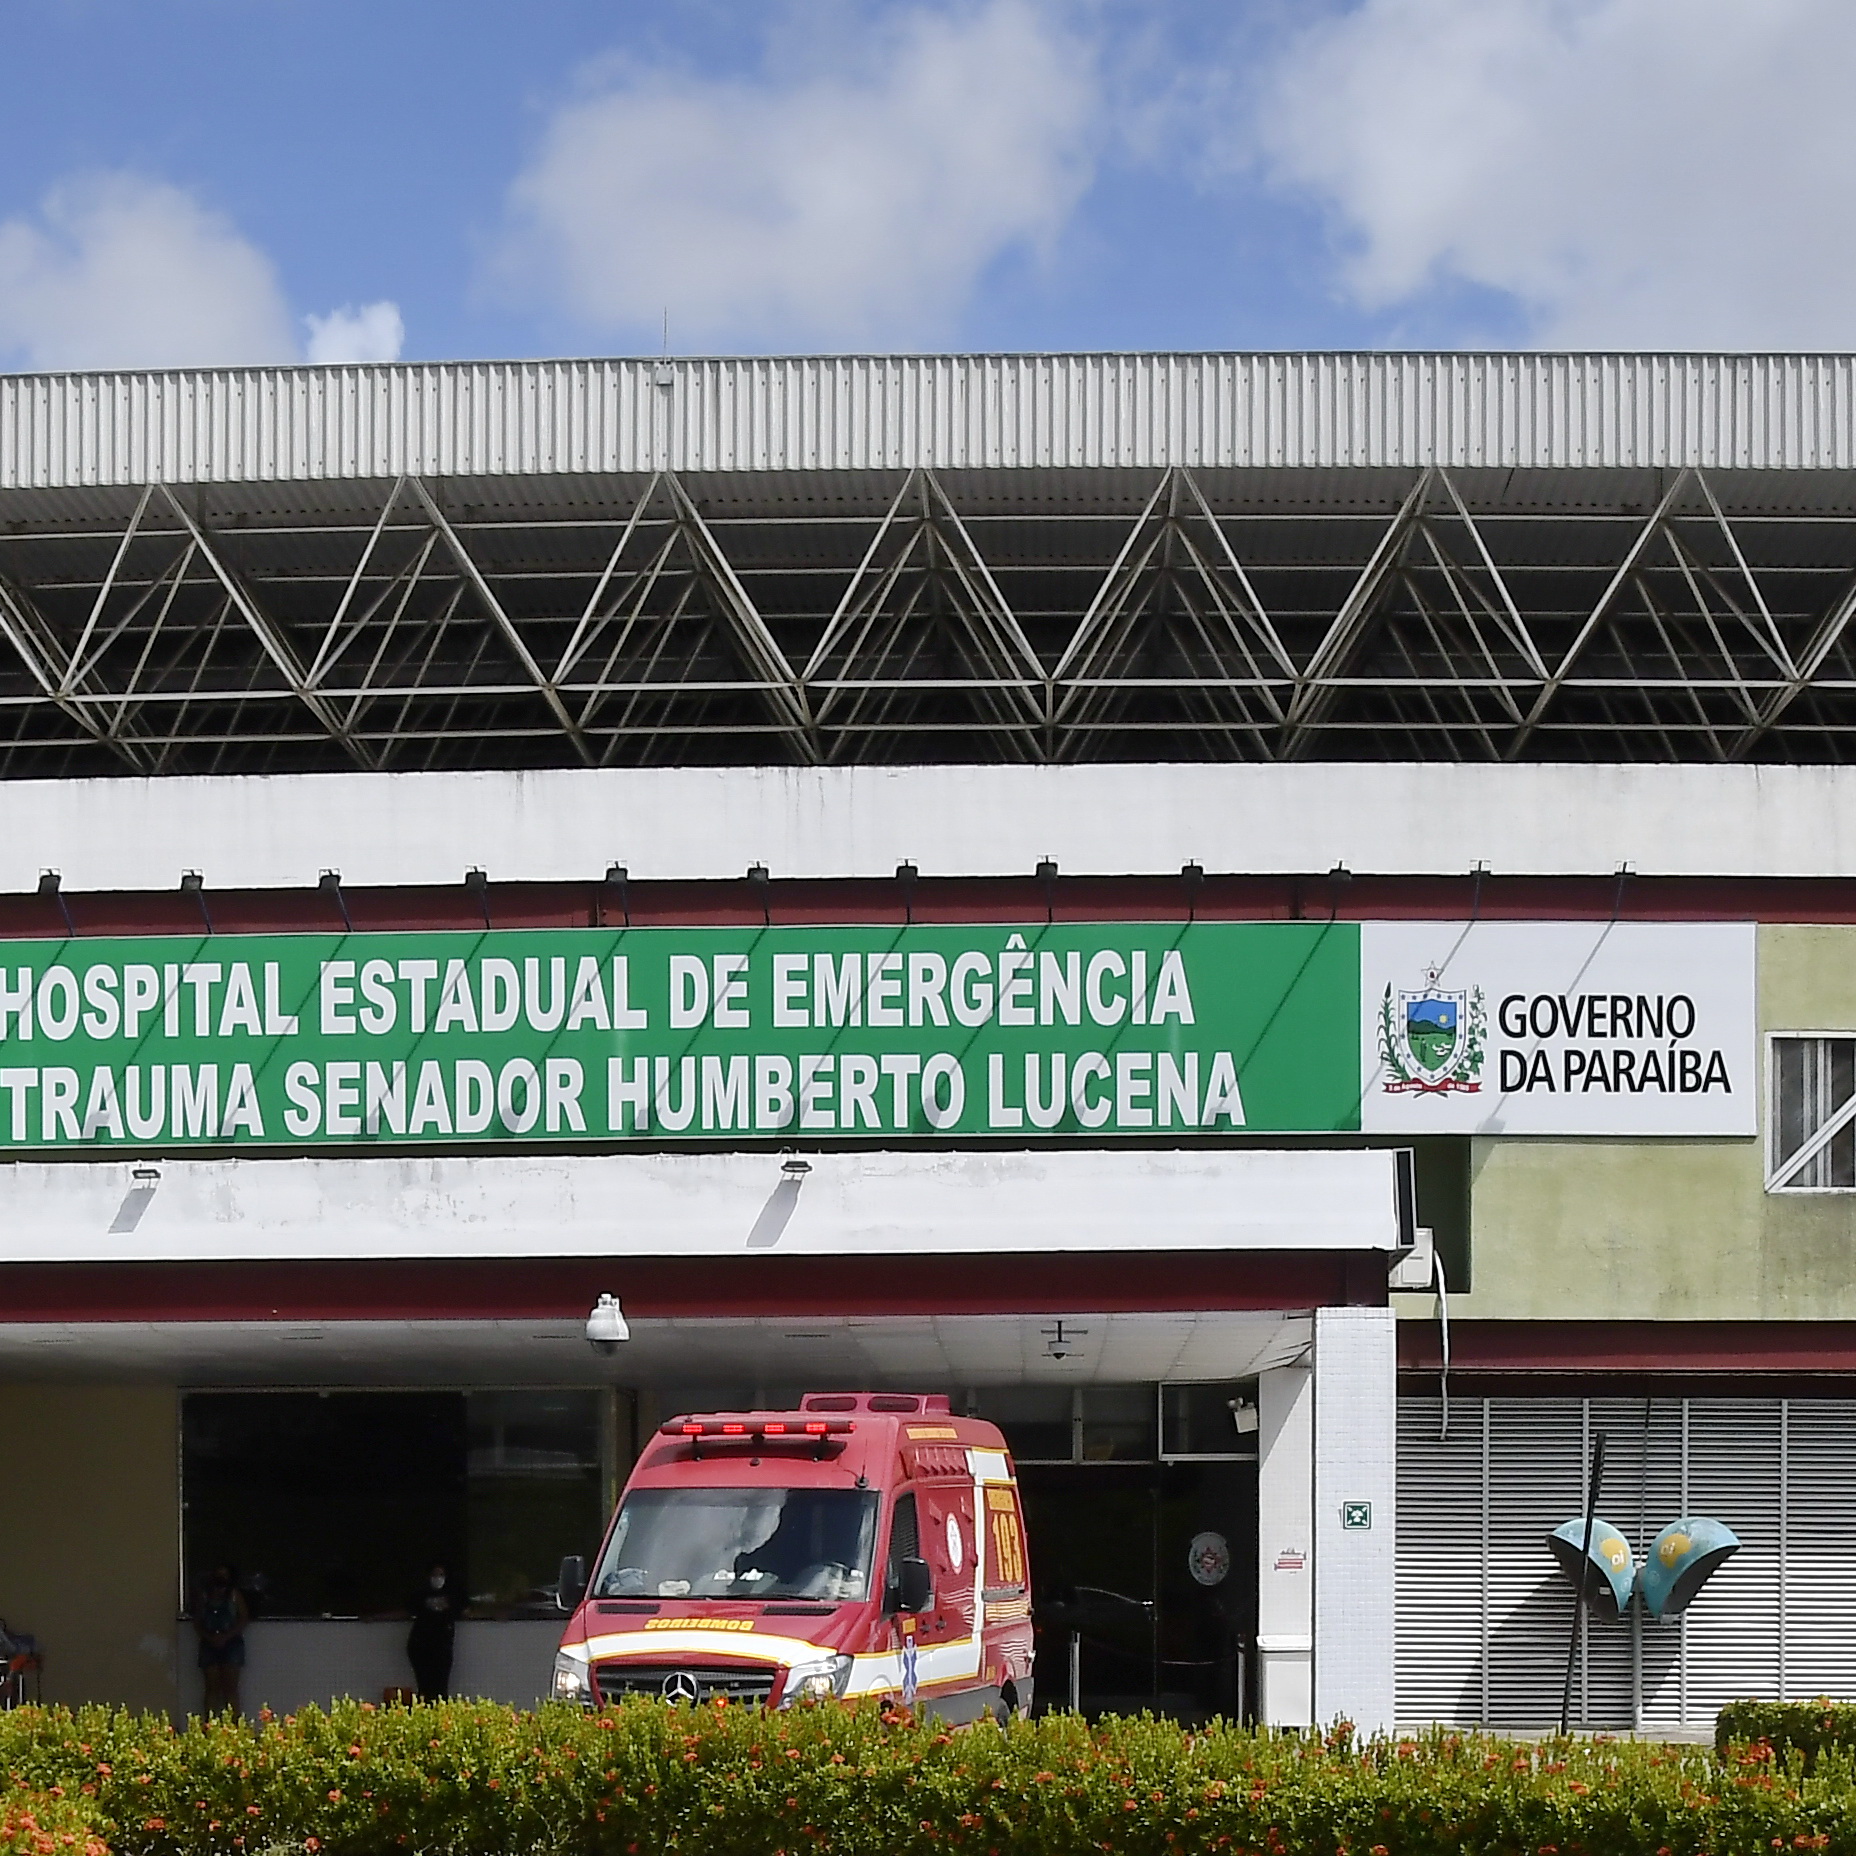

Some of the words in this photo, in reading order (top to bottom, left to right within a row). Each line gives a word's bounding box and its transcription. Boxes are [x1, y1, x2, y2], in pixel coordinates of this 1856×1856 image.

[320, 955, 648, 1035] ESTADUAL
[669, 954, 750, 1029] DE
[773, 933, 1195, 1028] EMERGÊNCIA
[1499, 994, 1696, 1039] GOVERNO
[0, 1063, 265, 1141] TRAUMA
[283, 1057, 587, 1137] SENADOR
[607, 1053, 965, 1131] HUMBERTO
[988, 1051, 1246, 1128] LUCENA
[1500, 1050, 1556, 1094] DA
[1564, 1039, 1733, 1094] PARAÍBA
[992, 1513, 1022, 1583] 193
[1611, 1549, 1624, 1566] oi
